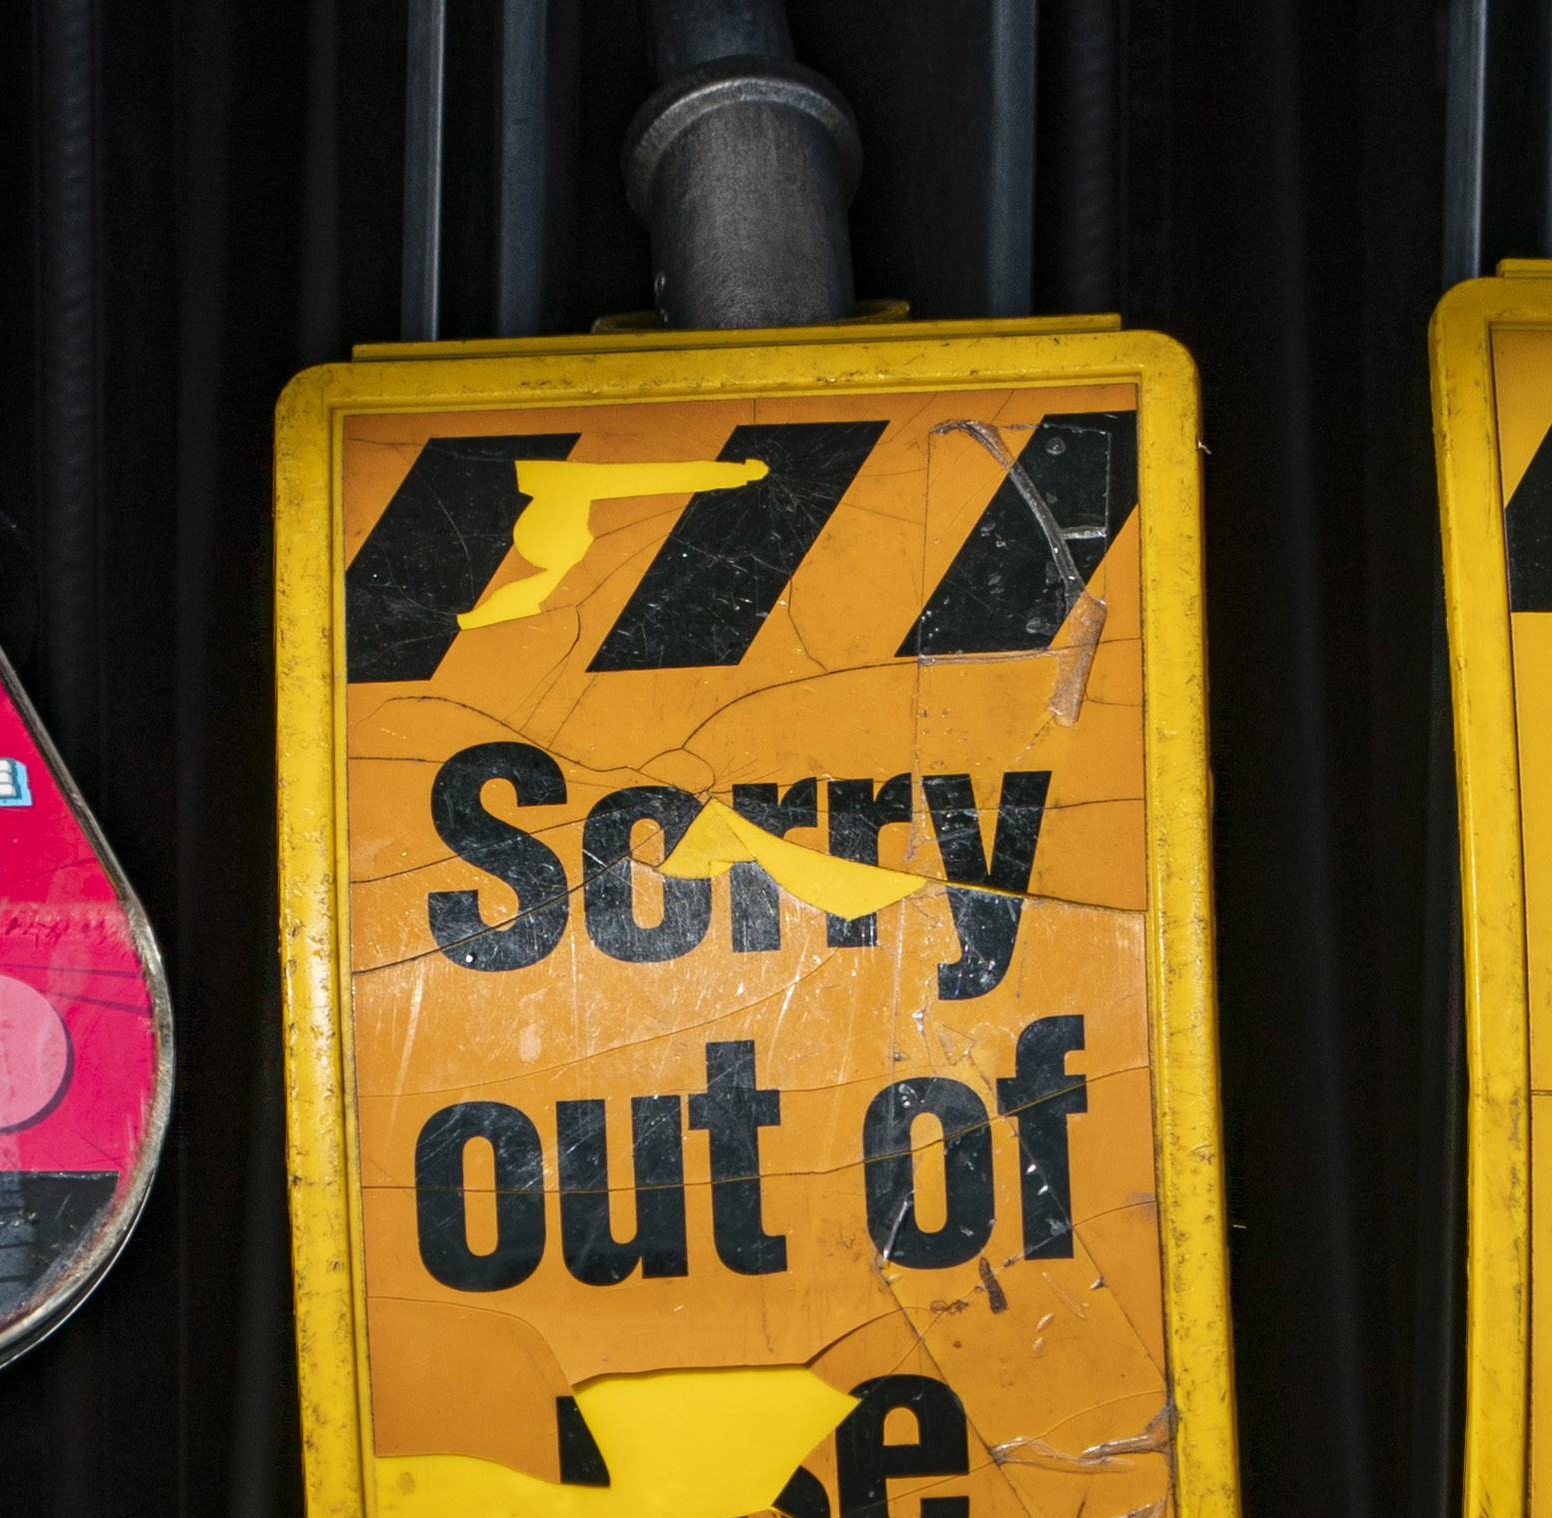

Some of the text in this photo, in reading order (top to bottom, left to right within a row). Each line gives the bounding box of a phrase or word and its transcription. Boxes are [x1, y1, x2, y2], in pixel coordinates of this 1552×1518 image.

[428, 740, 1053, 1001] Sorry
[413, 1014, 1089, 1292] out of
